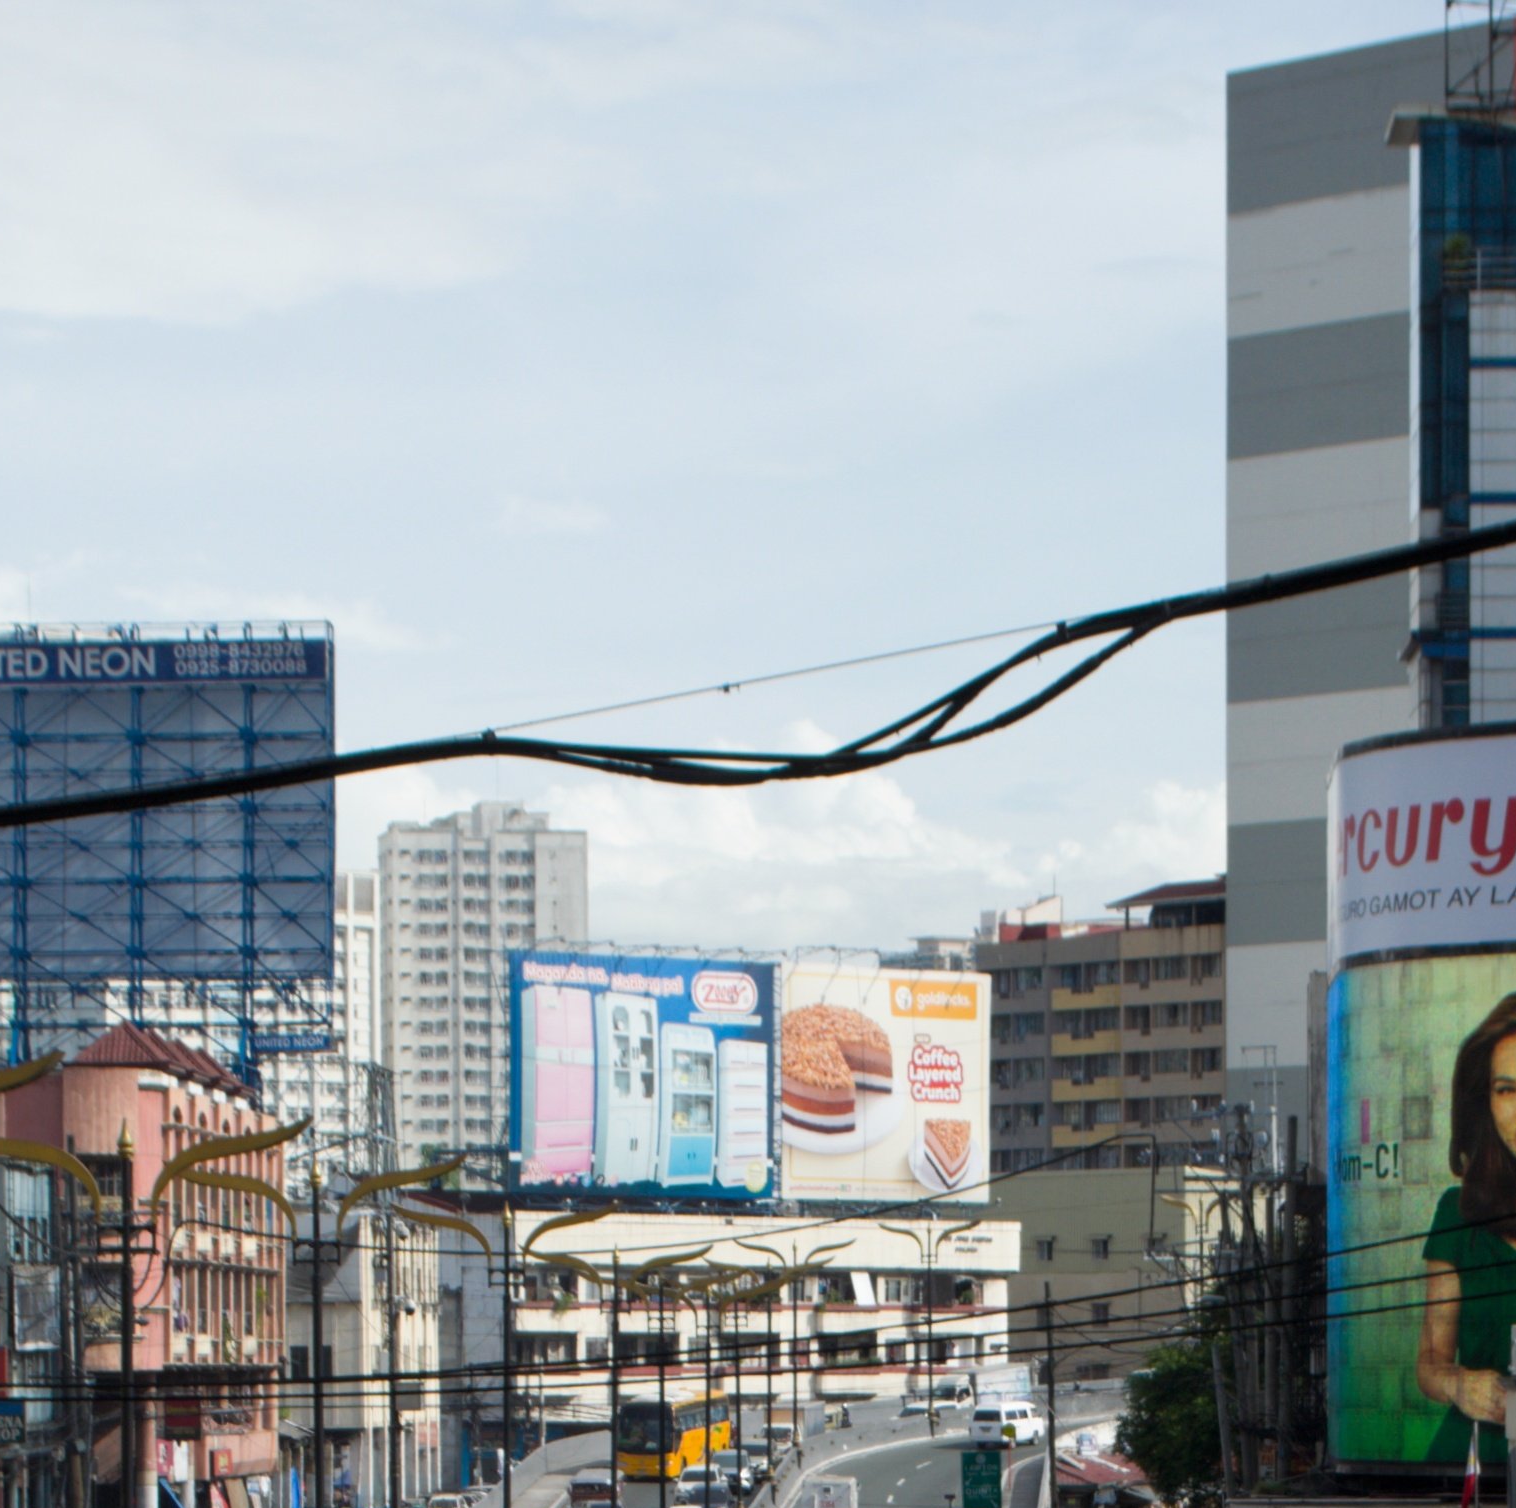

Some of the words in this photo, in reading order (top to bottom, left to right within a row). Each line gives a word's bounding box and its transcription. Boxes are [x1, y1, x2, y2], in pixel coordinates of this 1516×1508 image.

[174, 643, 305, 659] 0998-8432976
[58, 647, 157, 678] NEON
[175, 660, 308, 676] 0925-8730088
[1369, 888, 1442, 916] GAMOT
[1446, 886, 1481, 908] AY
[254, 1035, 292, 1049] UNITED
[293, 1034, 325, 1047] NEON
[914, 1046, 959, 1067] Coffee
[909, 1062, 962, 1087] Layered
[912, 1083, 961, 1102] Crunch
